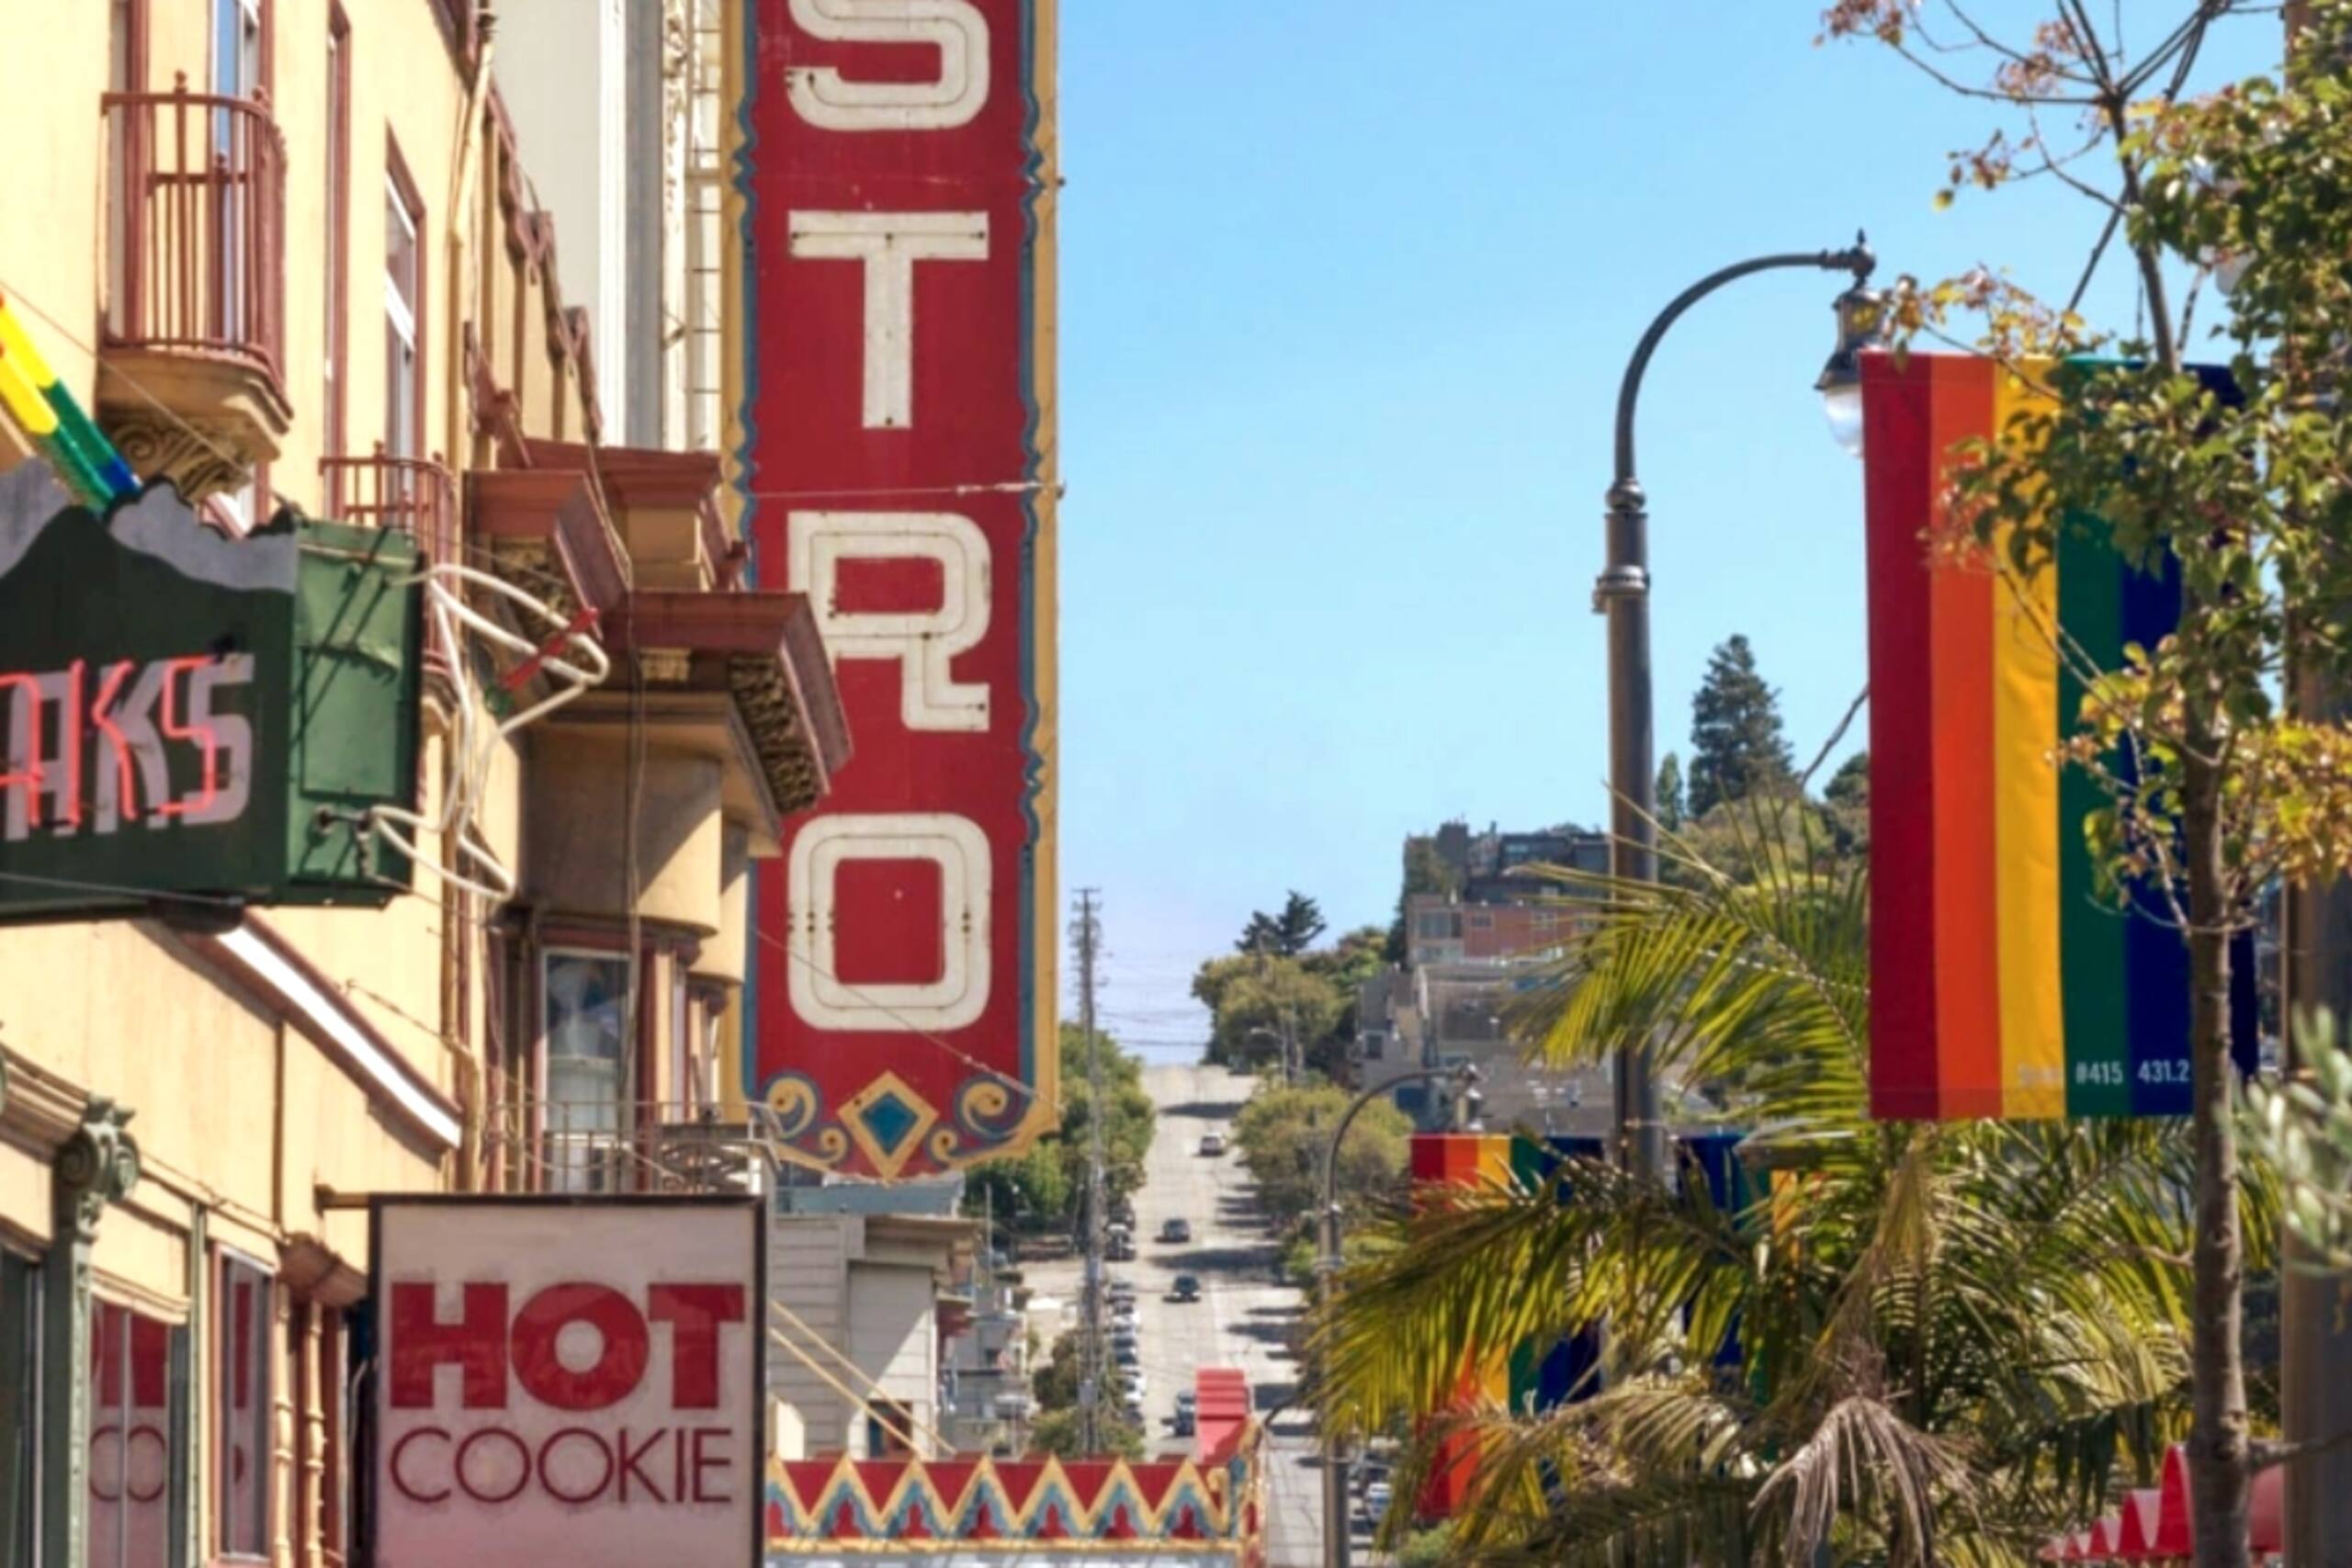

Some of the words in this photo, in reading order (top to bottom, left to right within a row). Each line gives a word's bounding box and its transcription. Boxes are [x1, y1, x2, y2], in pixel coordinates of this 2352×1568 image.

[787, 0, 991, 1030] STRO
[0, 652, 254, 841] AKS
[390, 1281, 745, 1410] HOT
[390, 1427, 732, 1504] COOKIE
